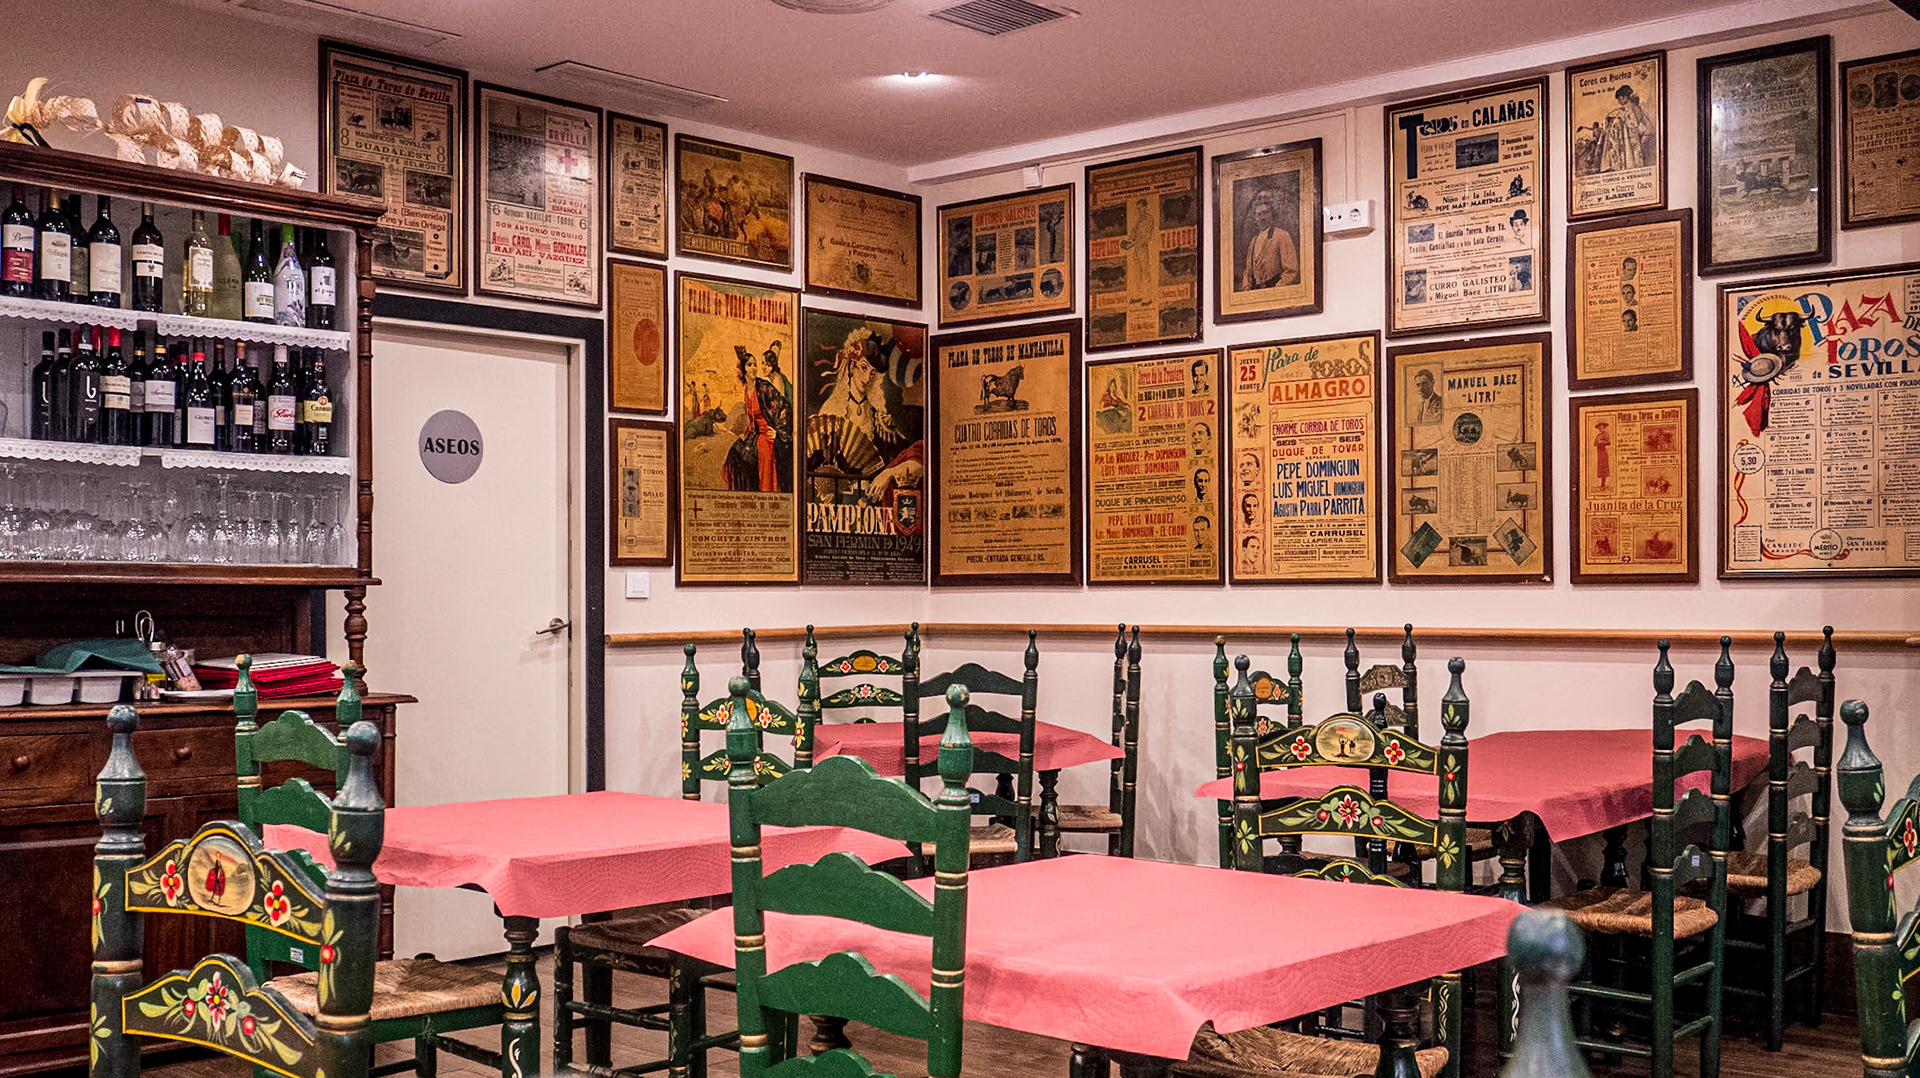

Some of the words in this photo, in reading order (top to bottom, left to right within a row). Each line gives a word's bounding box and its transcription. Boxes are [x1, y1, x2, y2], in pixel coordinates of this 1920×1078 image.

[1461, 120, 1469, 128] en
[1472, 99, 1535, 127] CALAÑAS
[341, 127, 349, 146] 8
[437, 145, 446, 163] 8
[1435, 204, 1449, 212] PEPE
[1470, 197, 1503, 207] MARTINEZ
[1429, 281, 1457, 291] CURRO
[1462, 275, 1507, 287] GALISTEO
[1435, 290, 1459, 300] Miguel
[1484, 284, 1507, 294] LITRI
[688, 288, 711, 315] PLAZA
[725, 293, 746, 319] TOROS
[760, 298, 788, 325] SEVILLA
[1794, 292, 1903, 346] PLAZA
[948, 350, 969, 369] PLAZA
[972, 348, 981, 366] DE
[983, 346, 1004, 364] TOROS
[1006, 345, 1015, 361] DE
[1018, 338, 1065, 360] MANZANILLA
[1239, 357, 1260, 366] JUEVES
[1304, 347, 1319, 362] de
[1309, 340, 1372, 379] TOROS
[1240, 365, 1256, 382] 25
[1262, 347, 1300, 390] Plaza
[1812, 370, 1822, 379] de
[1828, 360, 1920, 379] SEVILL
[1239, 382, 1261, 390] AGOSTO
[1272, 378, 1366, 403] ALMAGRO
[1448, 376, 1488, 391] MANUEL
[1493, 374, 1517, 386] BAEZ
[1772, 387, 1801, 396] CORRIDAS
[1812, 385, 1832, 393] TOROS
[1846, 381, 1883, 391] NOVILLADAS
[1138, 406, 1146, 421] 2
[1206, 400, 1215, 415] 2
[955, 422, 981, 444] CUATRO
[984, 419, 1018, 442] CORRIDAS
[1021, 418, 1030, 438] DE
[1034, 416, 1057, 437] TOROS
[1272, 422, 1298, 436] ENORME
[1300, 420, 1328, 434] CORRIDA
[1330, 420, 1339, 431] DE
[1341, 418, 1364, 431] TOROS
[424, 437, 480, 456] ASEOS
[1142, 438, 1166, 446] ANTONIO
[1272, 448, 1305, 458] DUQUE
[1312, 446, 1324, 455] DE
[1332, 444, 1364, 454] TOVAR
[1101, 465, 1115, 477] LUIS
[1118, 464, 1141, 476] MIGUEL
[1144, 461, 1180, 474] DOMINGUIN
[1277, 462, 1302, 480] PEPE
[1306, 459, 1360, 478] DOMINGUIN
[1272, 482, 1293, 499] LUIS
[1296, 480, 1331, 498] MIGUEL
[1334, 481, 1365, 496] DOMINGUIN
[1095, 498, 1121, 508] DUQUE
[1123, 497, 1133, 507] DE
[1134, 494, 1187, 506] PINOHERMOSO
[1300, 500, 1322, 516] PARRA
[1323, 497, 1365, 516] PARRITA
[1586, 500, 1627, 512] Juanita
[1629, 500, 1642, 510] de
[1644, 499, 1654, 510] la
[1656, 499, 1683, 509] Cruz
[806, 501, 898, 536] PAMPLONA
[1108, 515, 1124, 527] PEPE
[1127, 514, 1142, 526] LUIS
[1144, 512, 1175, 525] VAZQUEZ
[808, 535, 833, 548] SAN
[840, 536, 880, 550] FERMIN
[895, 535, 922, 553] 1949
[1124, 555, 1162, 565] CARRUSEL
